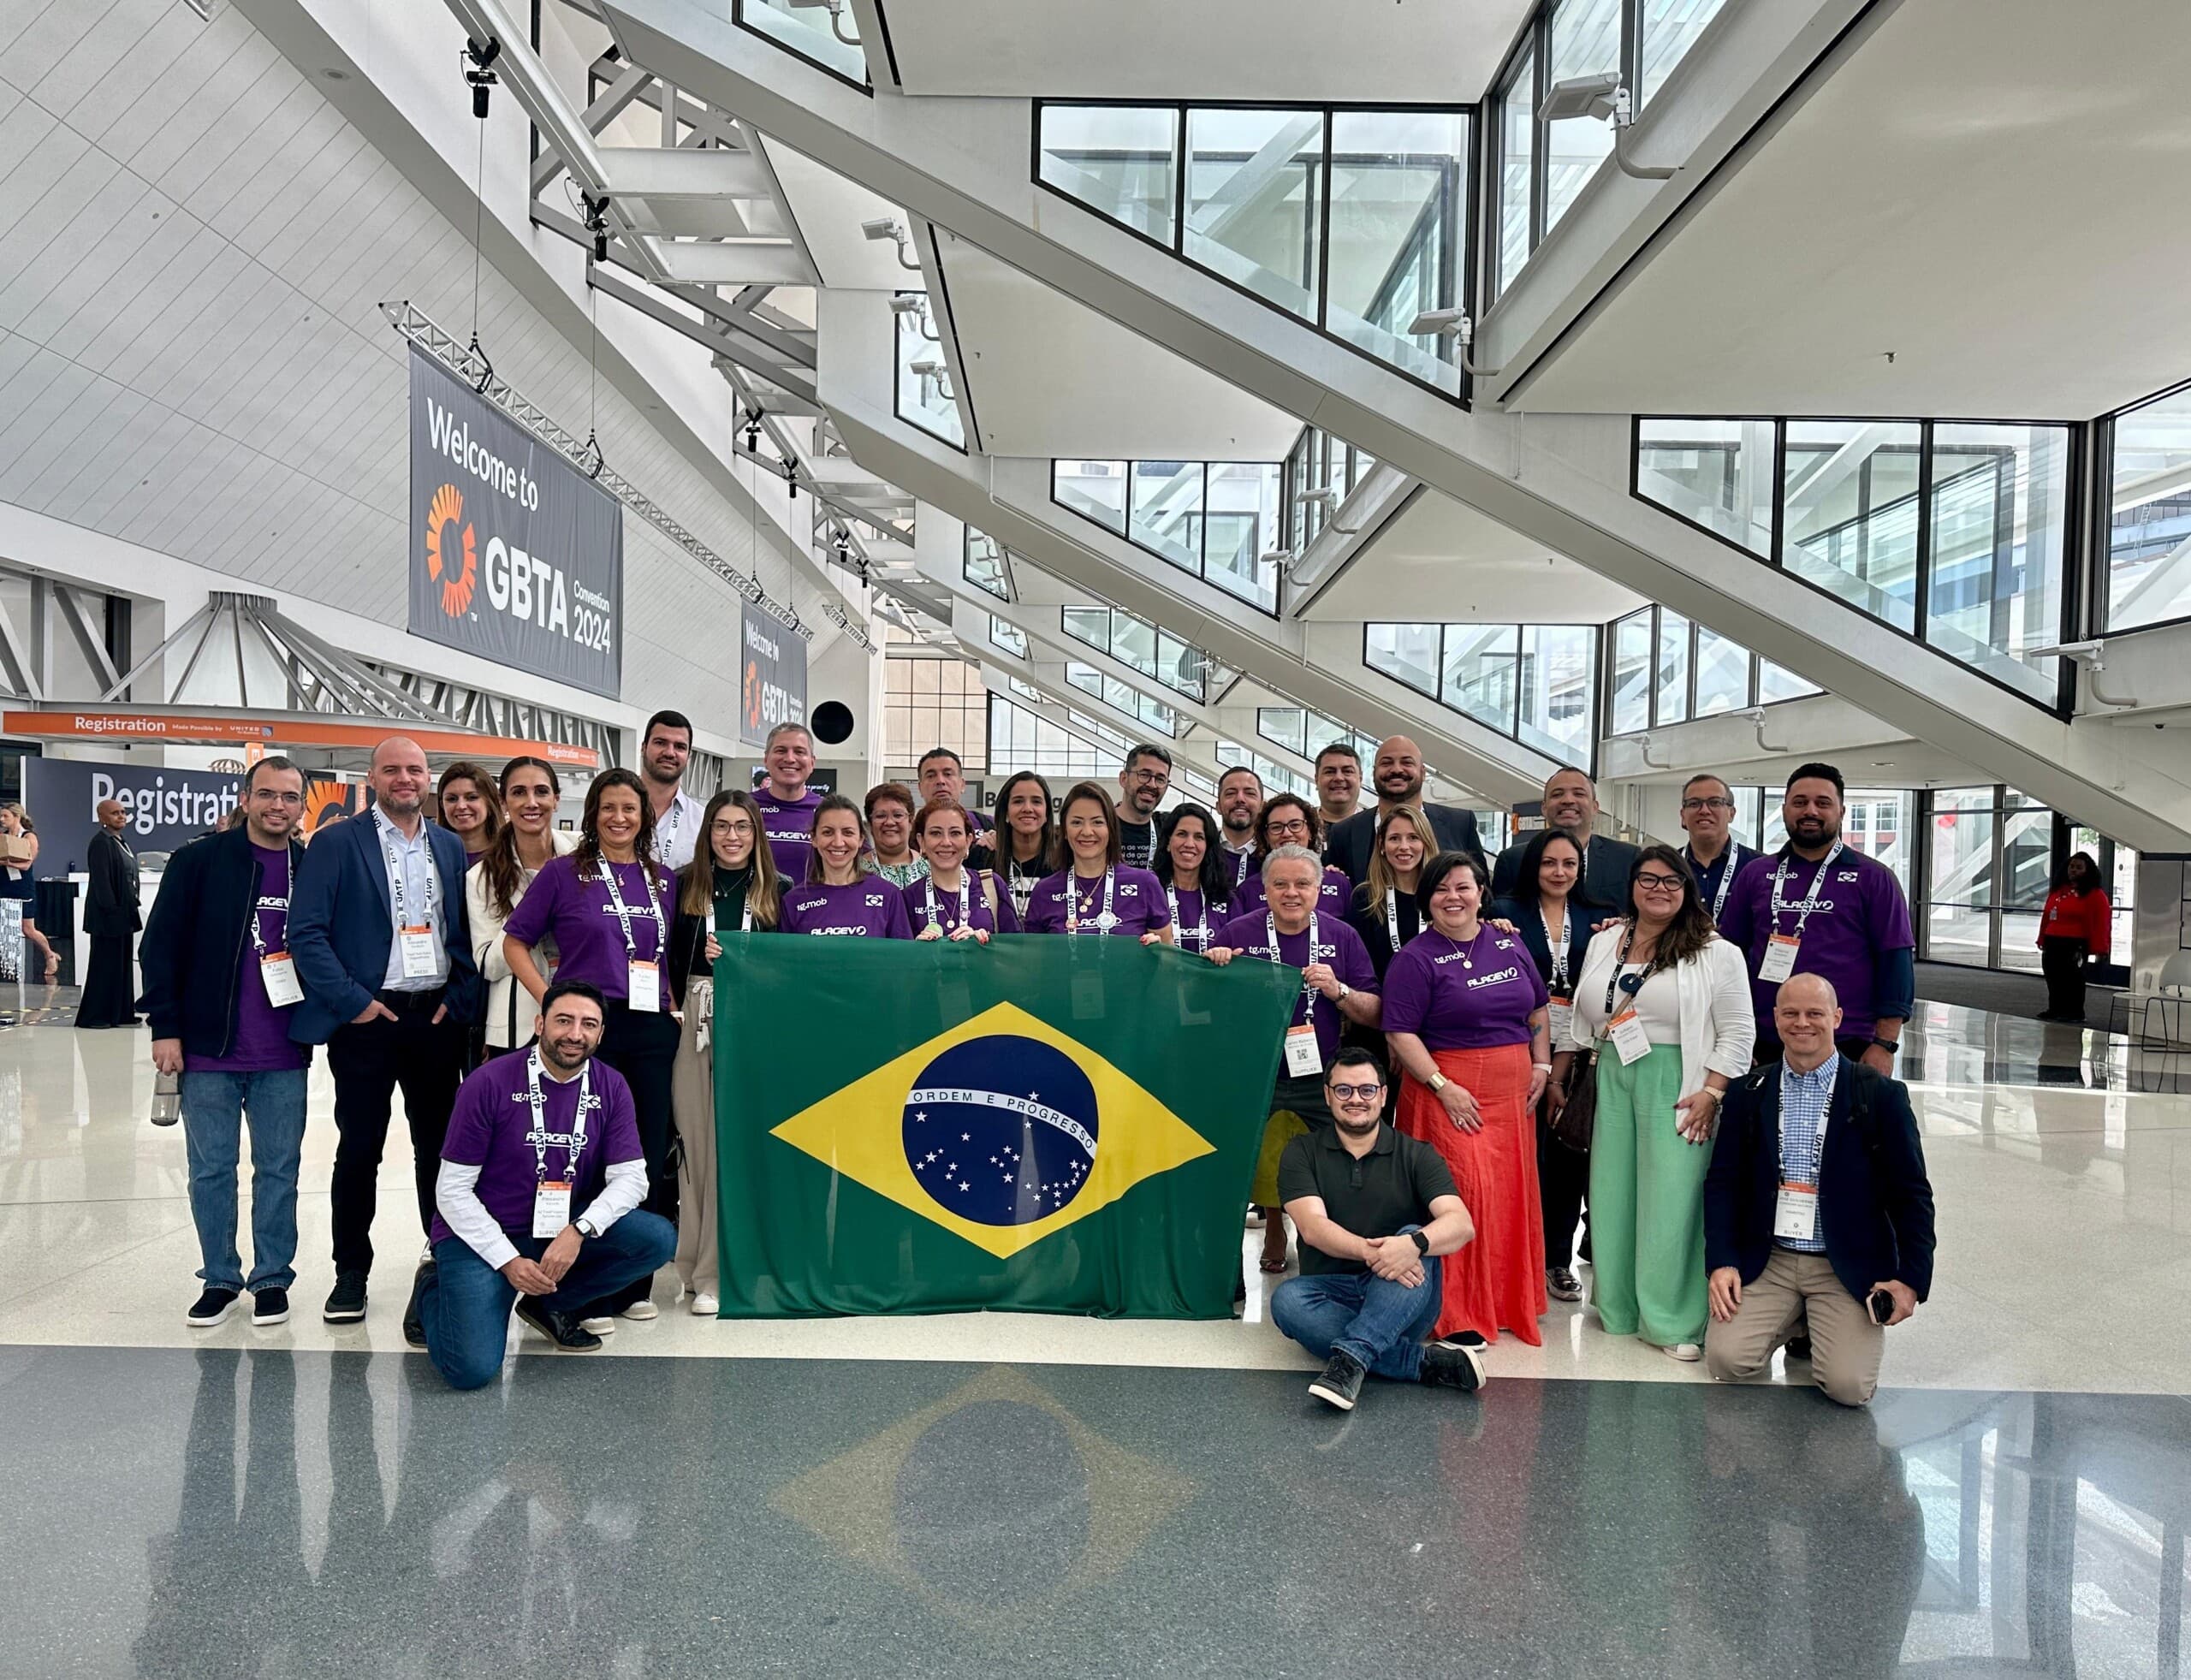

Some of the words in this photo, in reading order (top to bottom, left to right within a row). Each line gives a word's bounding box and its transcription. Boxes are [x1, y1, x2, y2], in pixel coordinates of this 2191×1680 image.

[427, 396, 517, 500] Welcome
[520, 467, 538, 512] to
[484, 536, 569, 638] GBTA
[573, 579, 610, 614] Convention
[573, 604, 611, 655] 2024
[745, 619, 773, 660] Welcome
[773, 639, 780, 662] to
[762, 681, 788, 725] GBTA
[74, 716, 166, 733] Registration
[92, 772, 240, 836] Registrati
[671, 810, 681, 828] UATP
[663, 839, 674, 858] UATP
[1723, 864, 1734, 883] UATP
[1778, 862, 1787, 880] UATP
[1816, 863, 1827, 884] UATP
[395, 878, 404, 902] UATP
[607, 878, 620, 899] UATP
[797, 897, 828, 911] tg.mob
[1772, 892, 1781, 911] UATP
[1802, 895, 1814, 916] UATP
[620, 912, 632, 935] UATP
[1170, 905, 1179, 925] UATP
[1391, 935, 1400, 951] UAT
[1562, 924, 1571, 944] UATP
[1271, 945, 1280, 964] UAT
[1434, 951, 1466, 965] tg.mob
[530, 1083, 541, 1110] UATP
[579, 1089, 589, 1116] UATP
[1822, 1092, 1834, 1118] UATP
[913, 1091, 973, 1102] ORDEM
[986, 1095, 995, 1104] E
[1006, 1098, 1094, 1149] PROGRESSO
[536, 1126, 545, 1153] UATP
[571, 1132, 582, 1157] UATP
[1814, 1133, 1824, 1159] UATP
